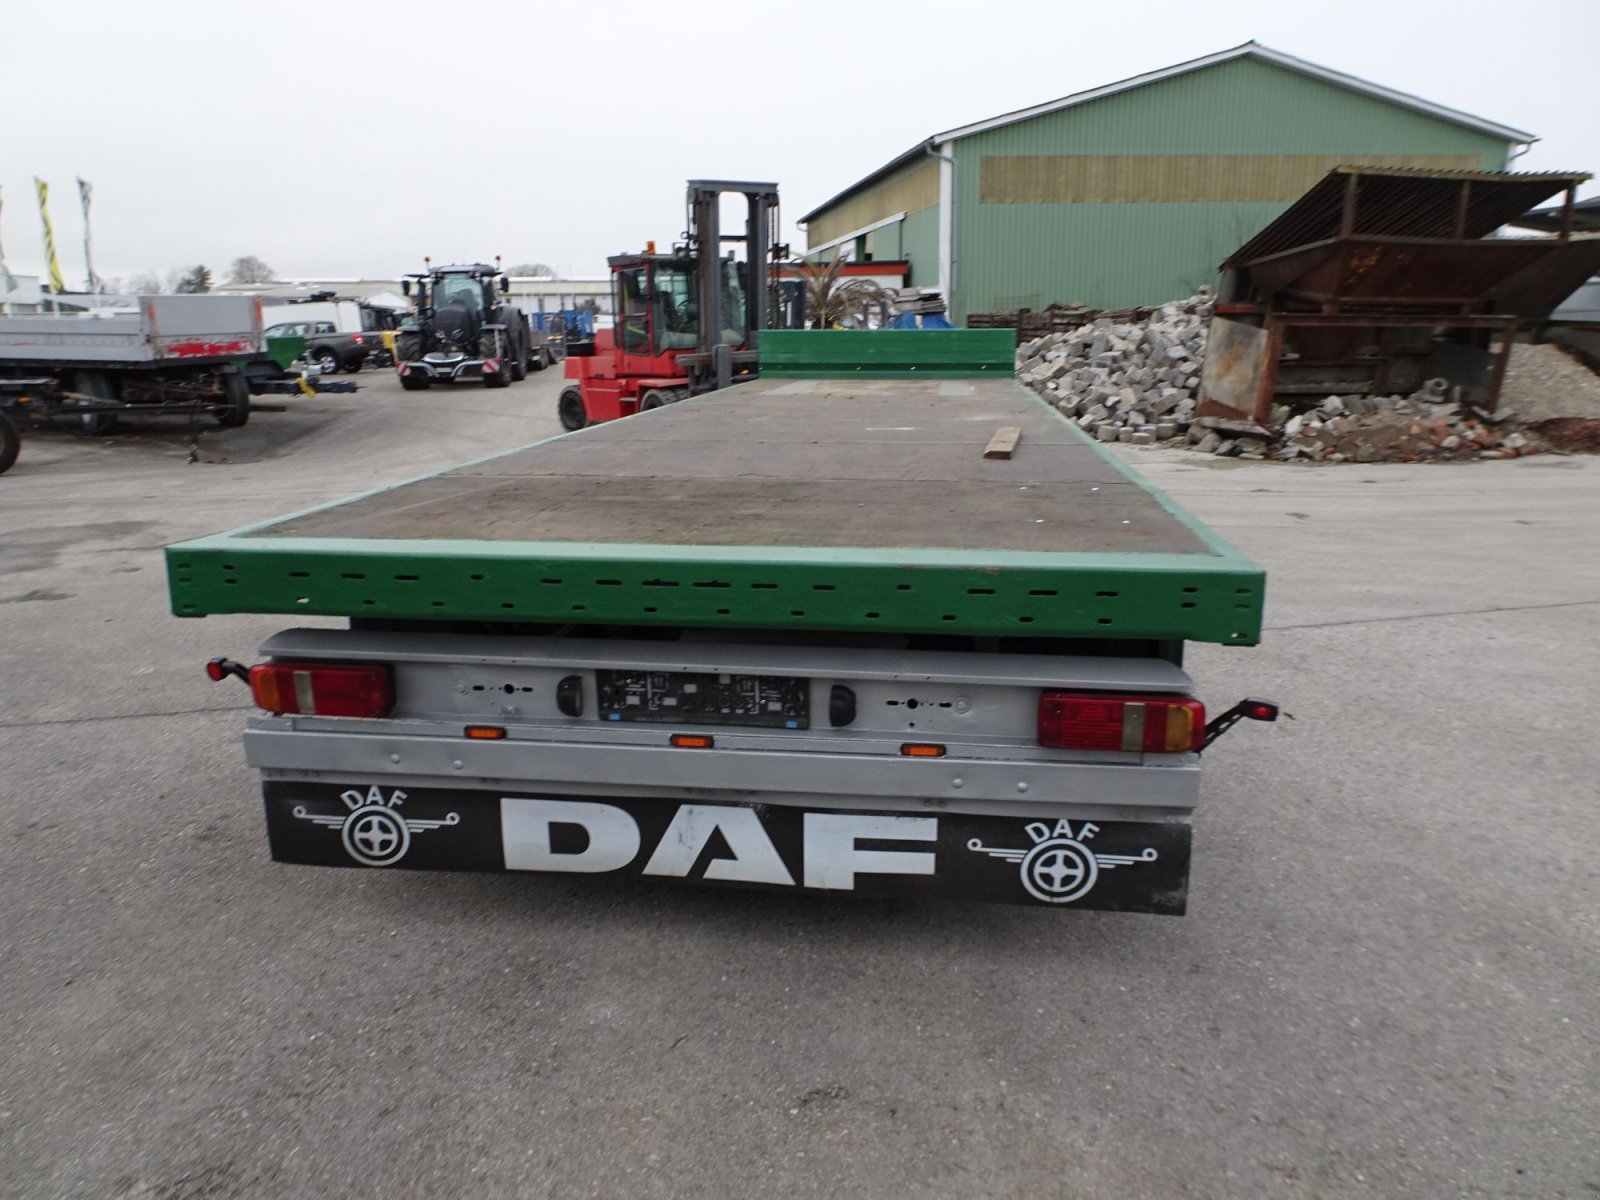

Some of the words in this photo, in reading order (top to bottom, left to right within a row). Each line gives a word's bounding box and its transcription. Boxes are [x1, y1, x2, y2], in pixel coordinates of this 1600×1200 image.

[340, 784, 408, 811] DAF
[500, 798, 938, 890] DAF
[1024, 819, 1100, 844] DAF
